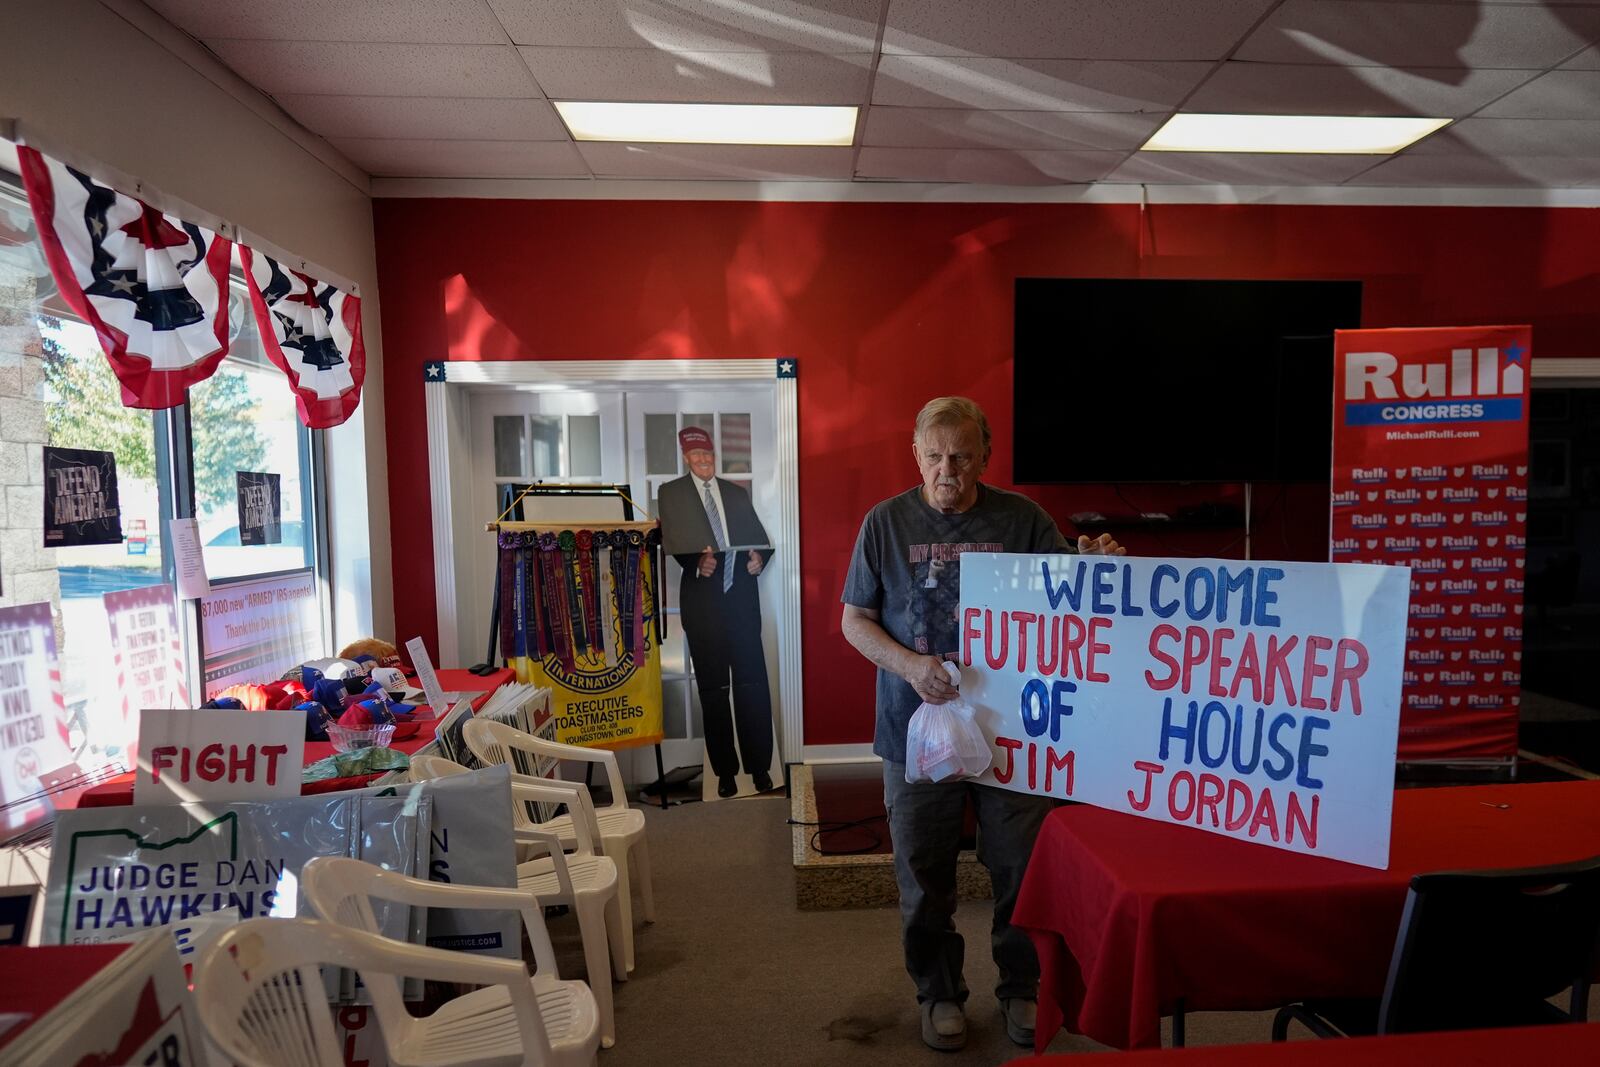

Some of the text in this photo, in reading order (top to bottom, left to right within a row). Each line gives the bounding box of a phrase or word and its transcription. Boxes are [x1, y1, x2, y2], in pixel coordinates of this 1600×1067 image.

[1344, 346, 1524, 400] Rulli
[1381, 404, 1484, 420] CONGRESS
[1386, 430, 1480, 441] MichaelRulli.com
[56, 465, 100, 496] DEFEND
[54, 491, 108, 525] AMERICA
[909, 544, 929, 563] MY
[201, 599, 229, 618] 87,000
[229, 600, 245, 612] new
[245, 589, 276, 609] "ARMED"
[276, 588, 287, 600] IRS
[1042, 561, 1285, 627] WELCOME
[225, 622, 248, 640] Thank
[963, 608, 1369, 716] FUTURE SPEAKER
[555, 706, 643, 729] TOASTMASTERS
[567, 696, 628, 715] EXECUTIVE
[580, 726, 595, 734] CLUB
[616, 727, 633, 736] OHIO
[1021, 678, 1331, 789] OF HOUSE
[151, 743, 288, 786] FIGHT
[993, 736, 1321, 849] JIM JORDAN
[80, 859, 283, 892] JUDGE DAN
[75, 890, 276, 930] HAWKINS
